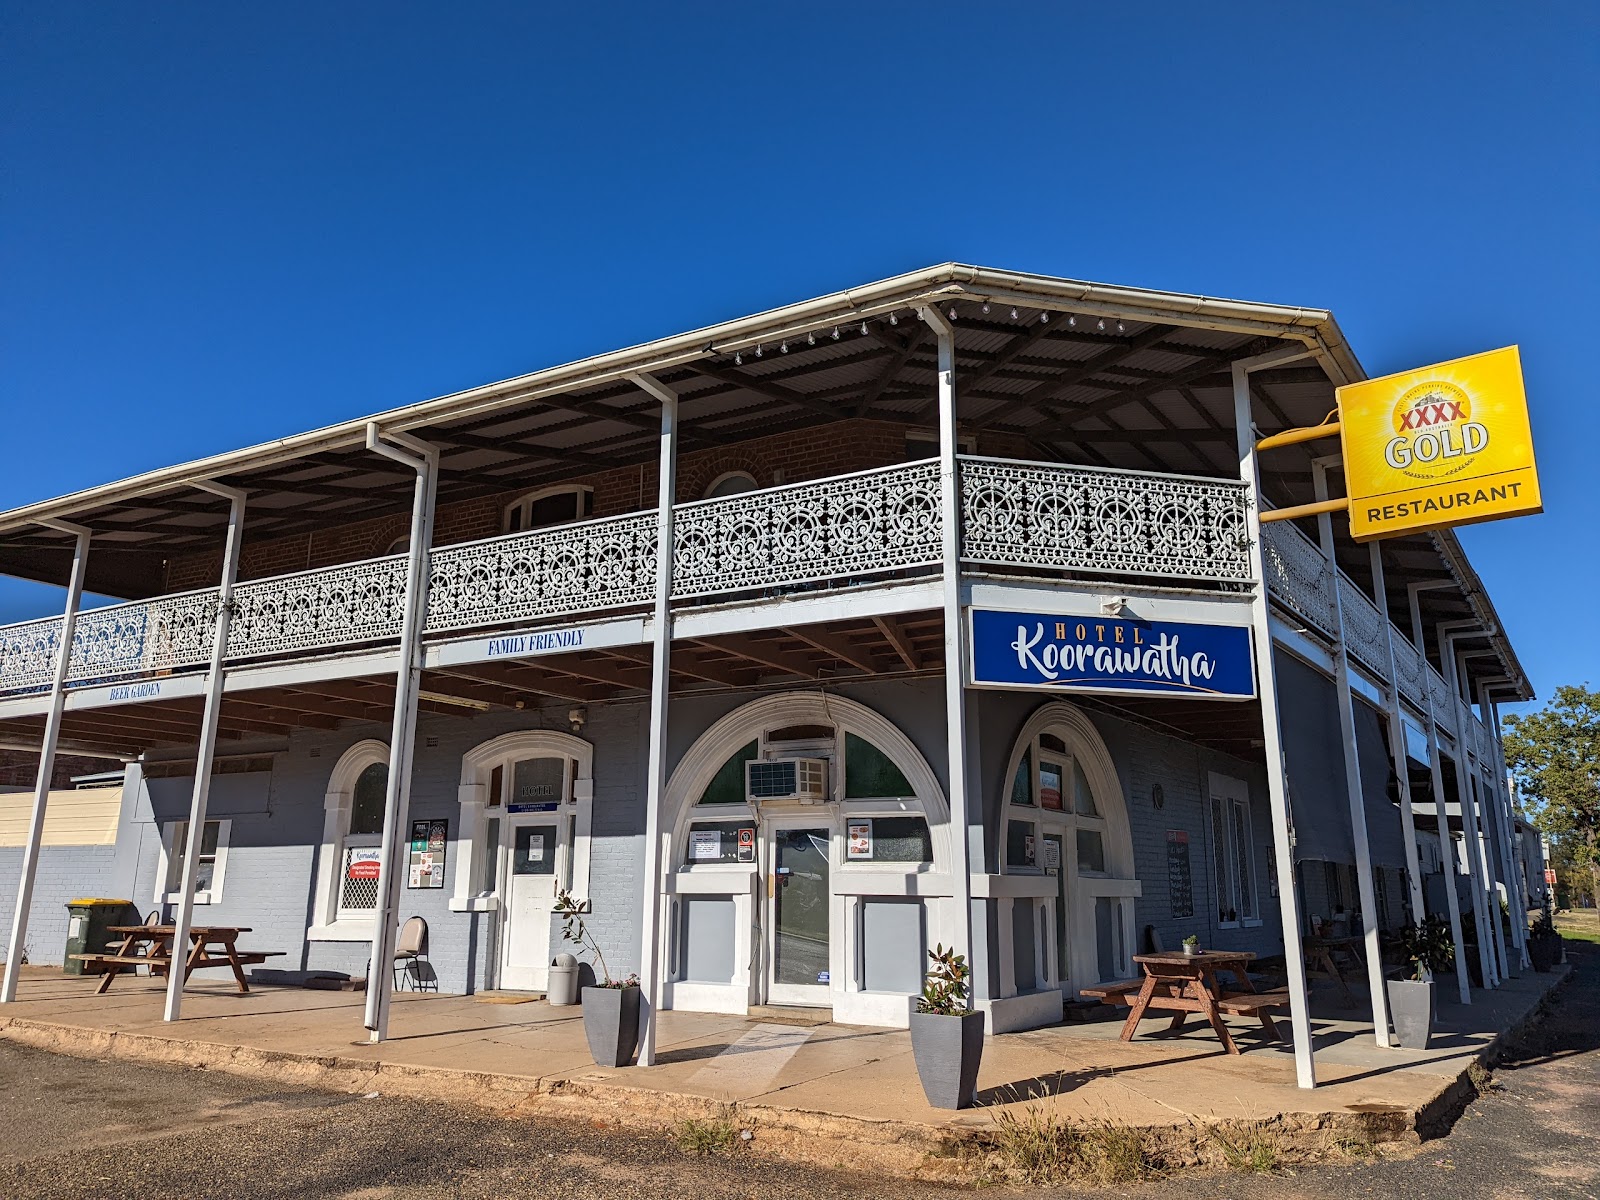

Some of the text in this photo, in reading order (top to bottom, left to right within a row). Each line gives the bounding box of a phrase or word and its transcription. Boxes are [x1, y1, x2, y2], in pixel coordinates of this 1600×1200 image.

[1399, 401, 1467, 432] XXXX
[1384, 422, 1489, 469] GOLD
[1367, 482, 1522, 523] RESTAURANT
[487, 629, 585, 656] FAMILY FRIENDLY
[1055, 622, 1143, 644] HOTEL
[1011, 622, 1216, 685] Koorawatha
[110, 682, 161, 701] BEER GARDEN
[521, 785, 554, 797] HOTEL
